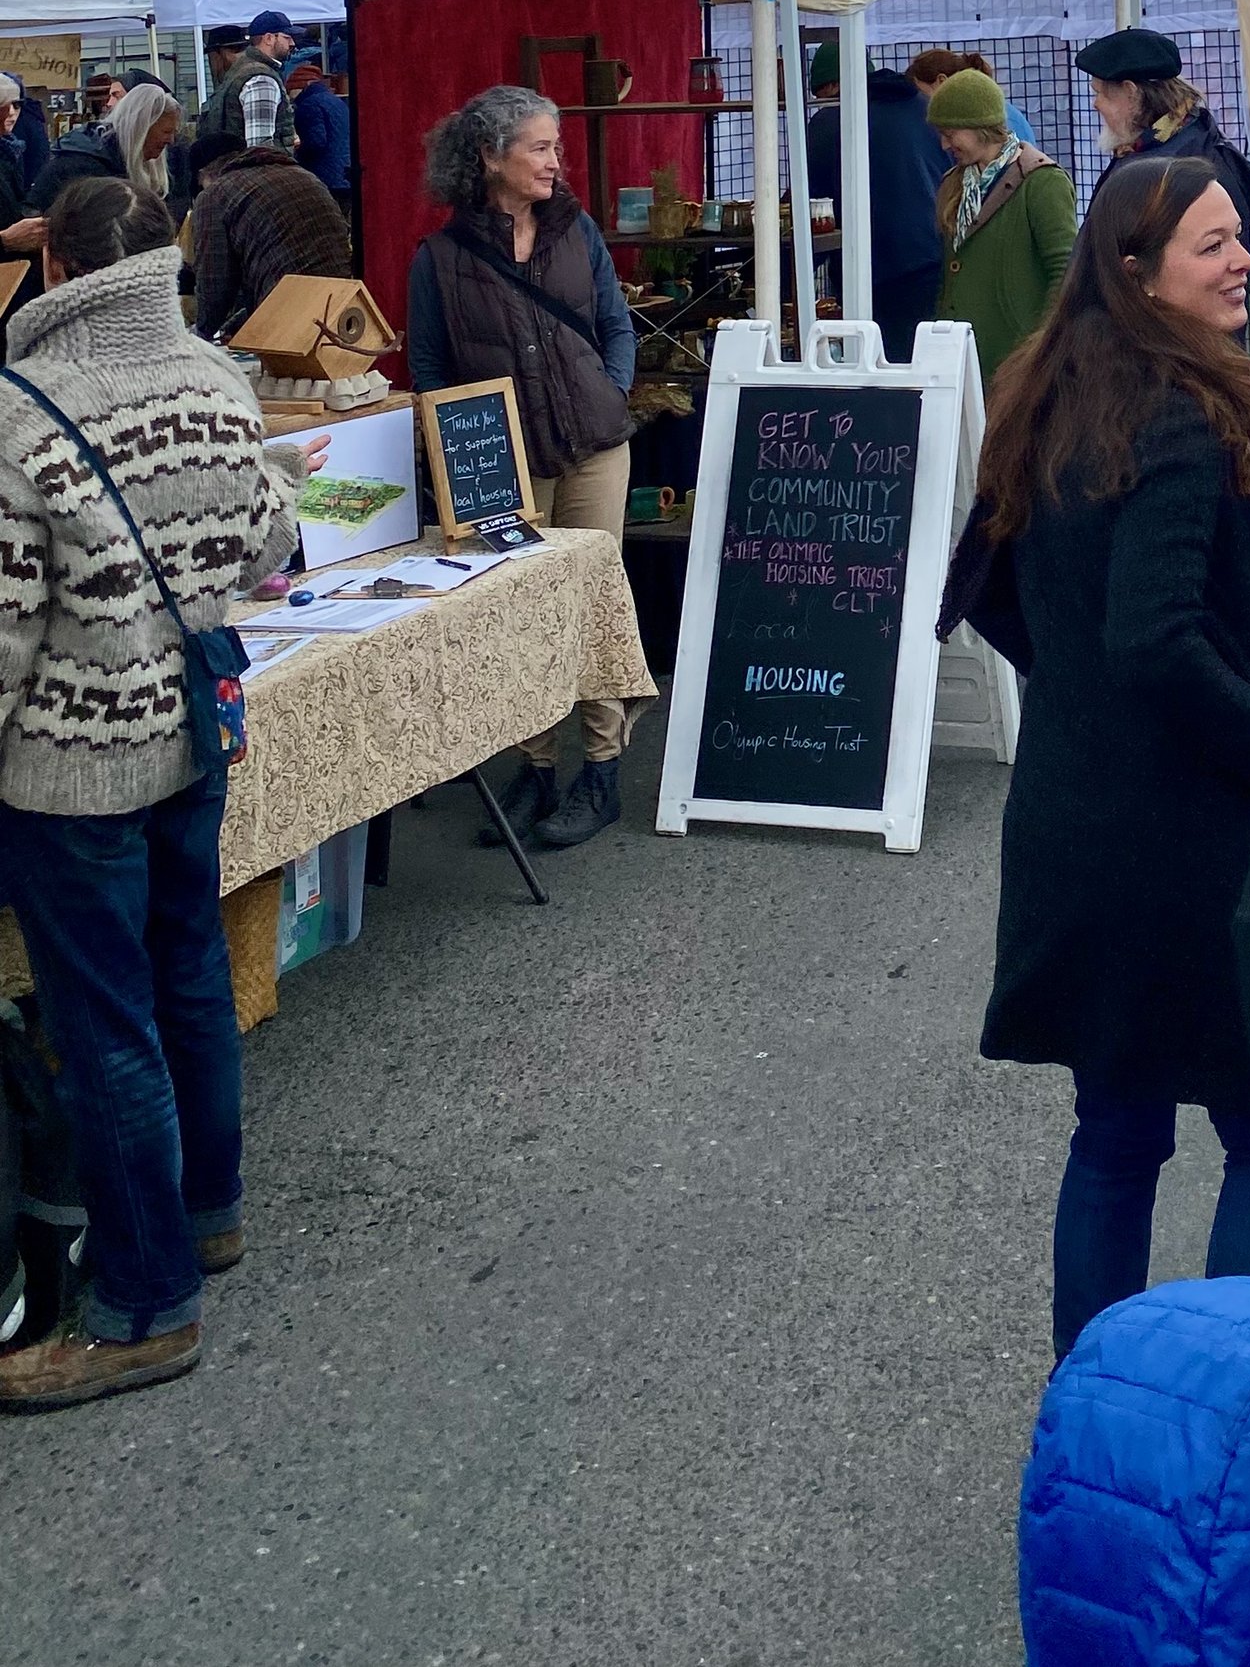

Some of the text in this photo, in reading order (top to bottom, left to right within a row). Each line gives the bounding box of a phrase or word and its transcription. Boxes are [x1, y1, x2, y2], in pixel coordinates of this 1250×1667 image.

[444, 410, 496, 433] THANK YOU
[757, 409, 854, 440] GET TO
[444, 434, 507, 454] for supporting
[757, 440, 912, 475] KNOW YOUR
[453, 453, 498, 475] local food
[453, 491, 475, 508] local
[748, 476, 901, 513] COMMUNITY
[745, 505, 902, 546] LAND TRUST
[733, 540, 834, 564] THE OLYMPIC
[765, 562, 898, 596] HOUSING TRUST,
[832, 590, 882, 614] CLT
[744, 665, 846, 696] HOUSING
[712, 719, 869, 764] Olympic Housing Trust
